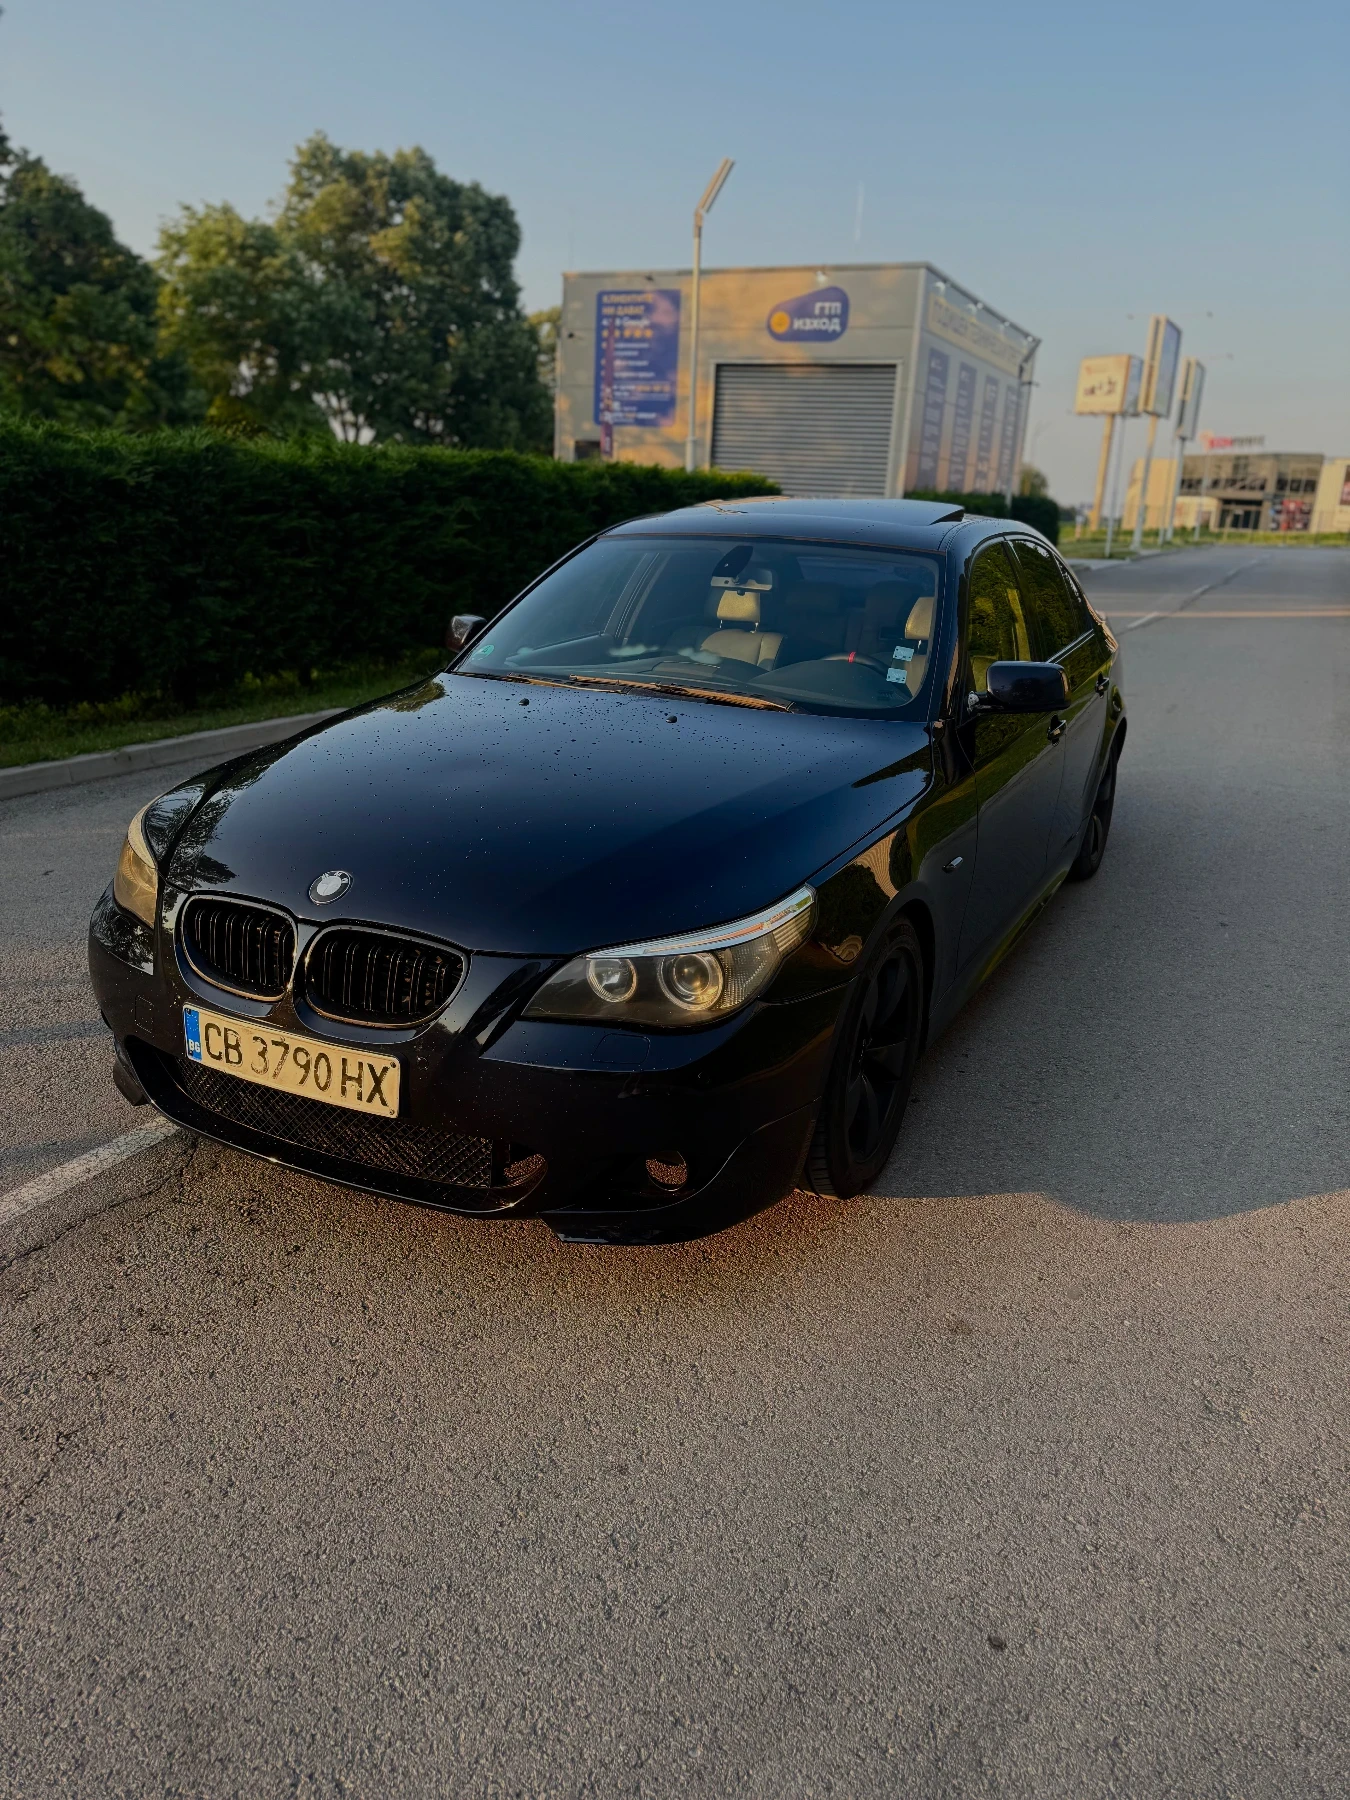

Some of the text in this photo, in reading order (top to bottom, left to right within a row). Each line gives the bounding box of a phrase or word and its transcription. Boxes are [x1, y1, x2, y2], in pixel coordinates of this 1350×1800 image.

[188, 1038, 201, 1053] BG
[204, 1022, 389, 1107] CB 3790 HX
